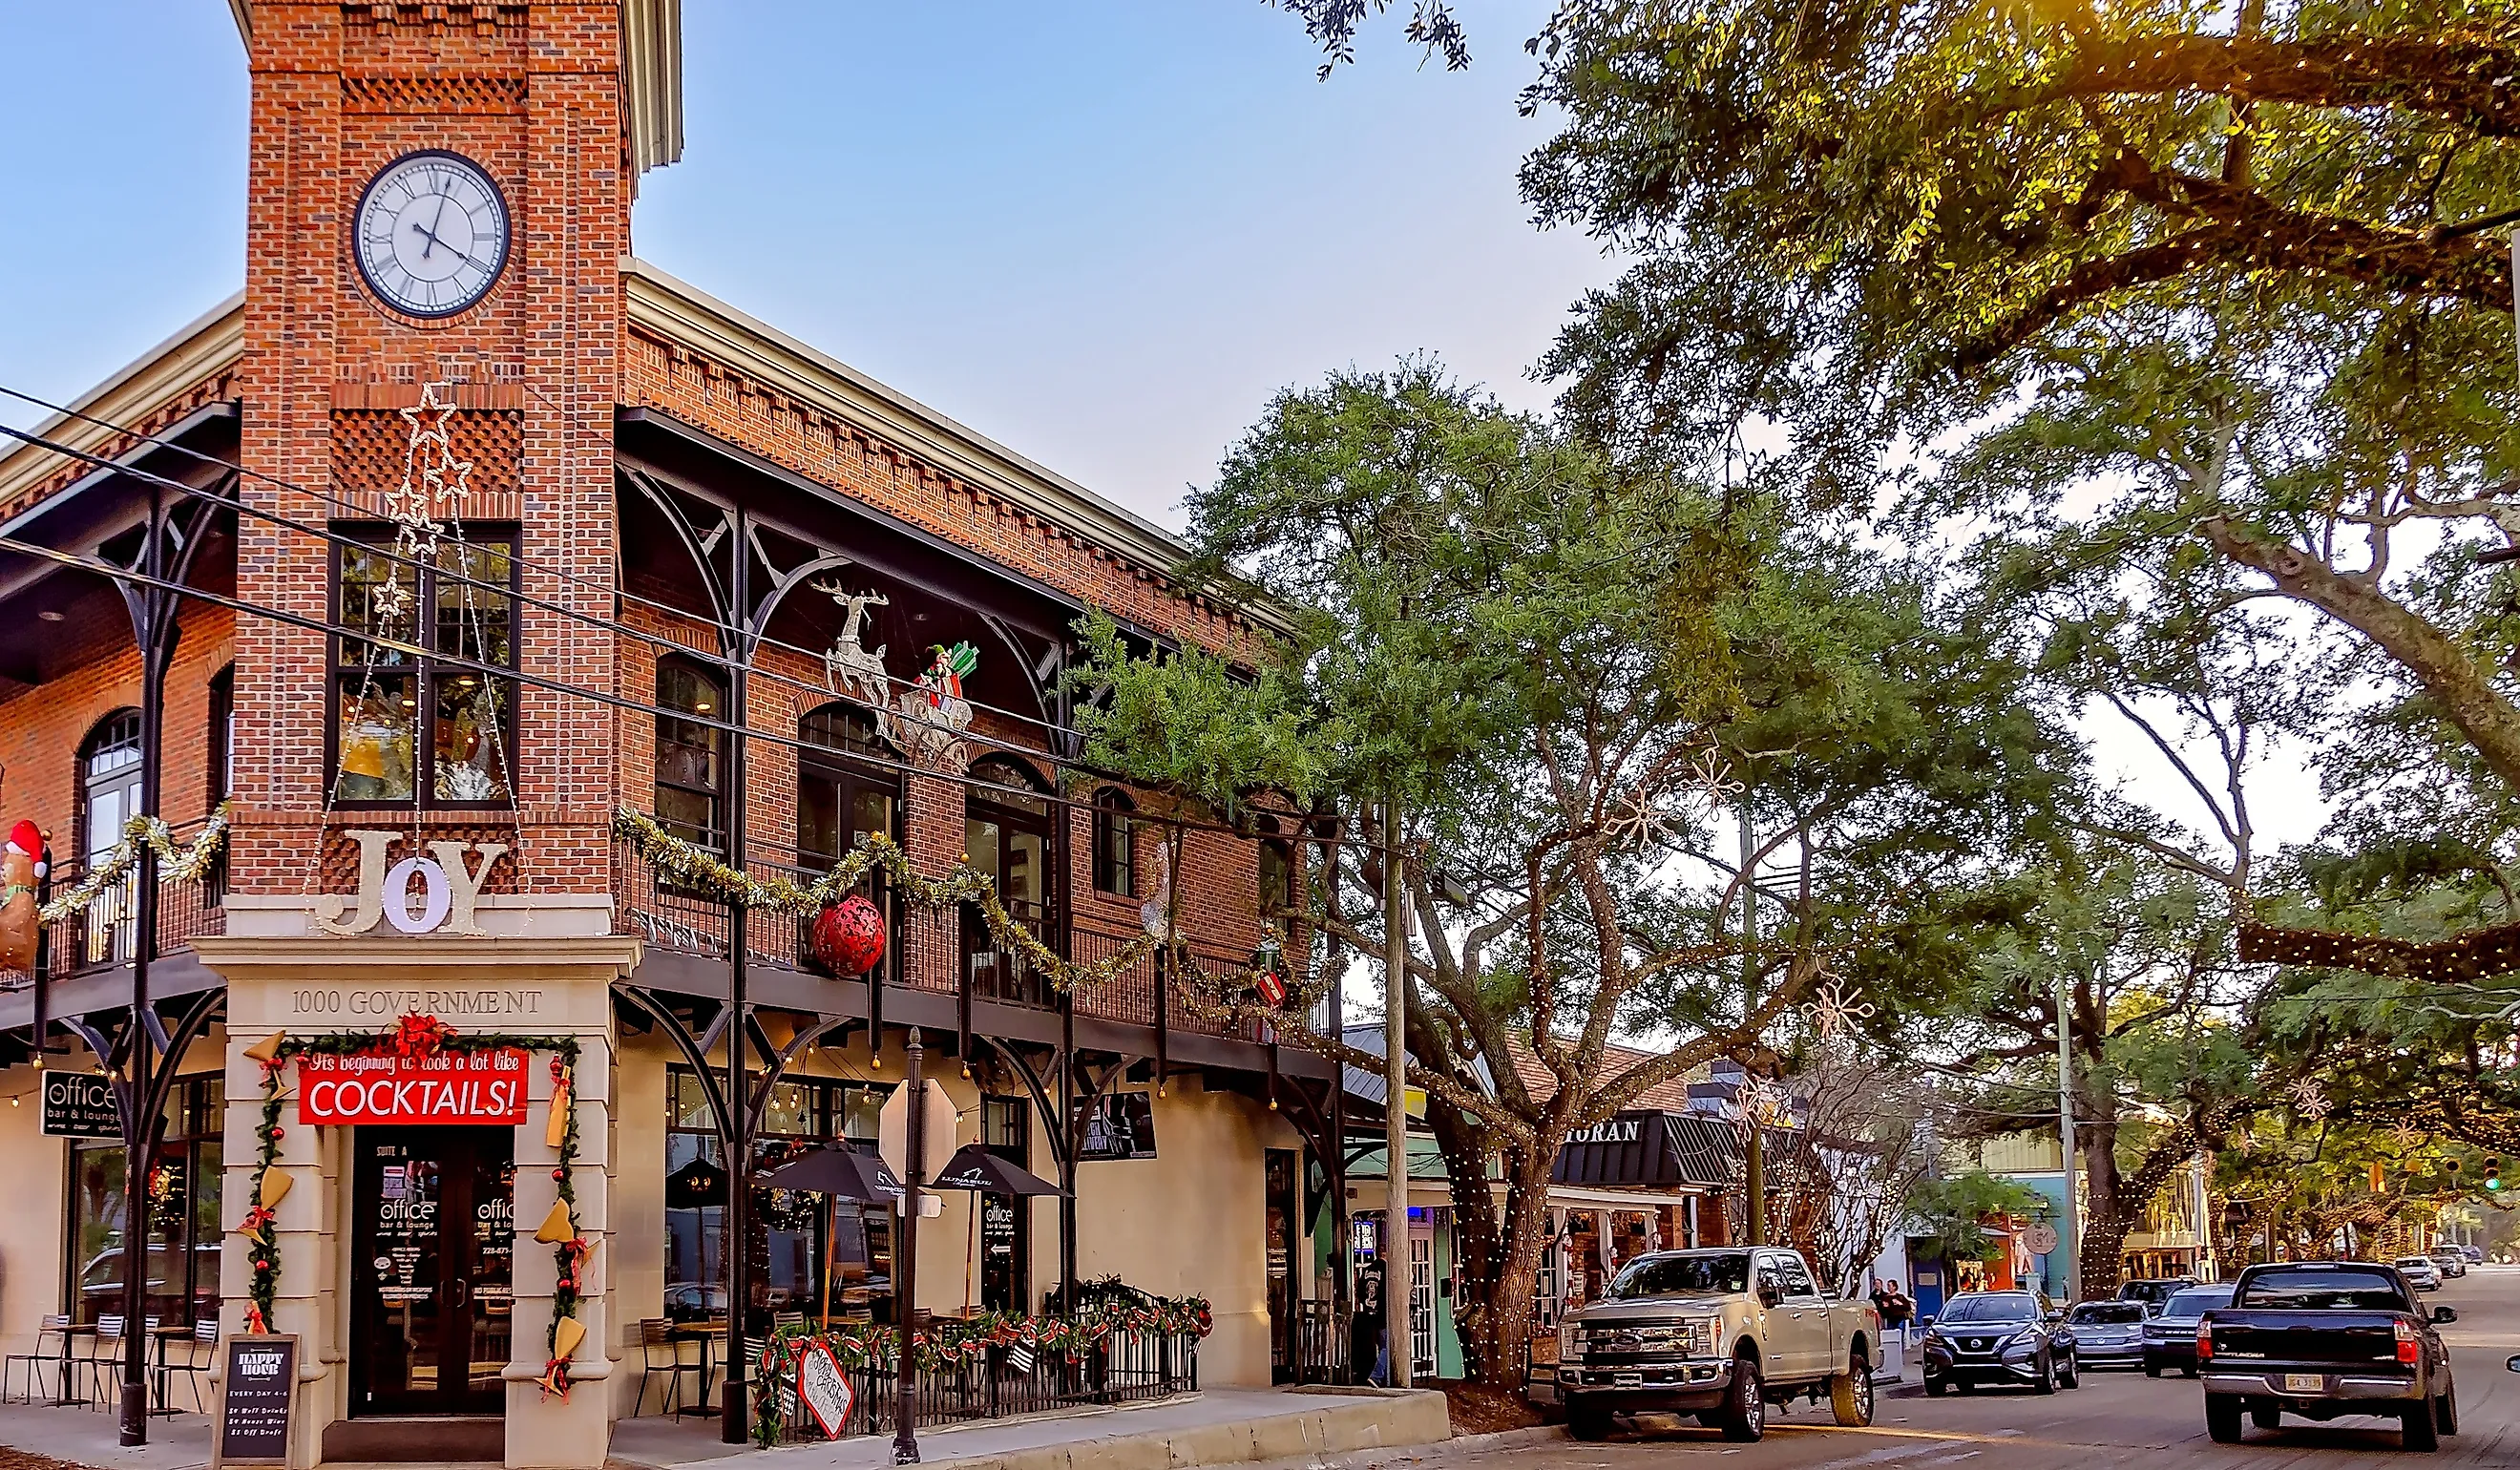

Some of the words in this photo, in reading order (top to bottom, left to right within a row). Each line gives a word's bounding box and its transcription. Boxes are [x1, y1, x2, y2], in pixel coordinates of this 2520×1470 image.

[293, 990, 340, 1014] 1000
[348, 990, 543, 1015] GOVERNMENT
[340, 1054, 396, 1076] beginning
[455, 1057, 465, 1070] a
[470, 1050, 489, 1070] lot
[494, 1050, 519, 1070] like
[49, 1077, 116, 1108] office
[309, 1080, 518, 1117] COCKTAILS!
[47, 1107, 66, 1118] bar
[71, 1109, 79, 1119] &
[381, 1199, 435, 1220] office
[477, 1199, 514, 1220] offic
[986, 1205, 1014, 1223] office
[406, 1221, 434, 1229] lounge
[239, 1354, 284, 1365] HAPPY
[241, 1364, 279, 1376] HOUR
